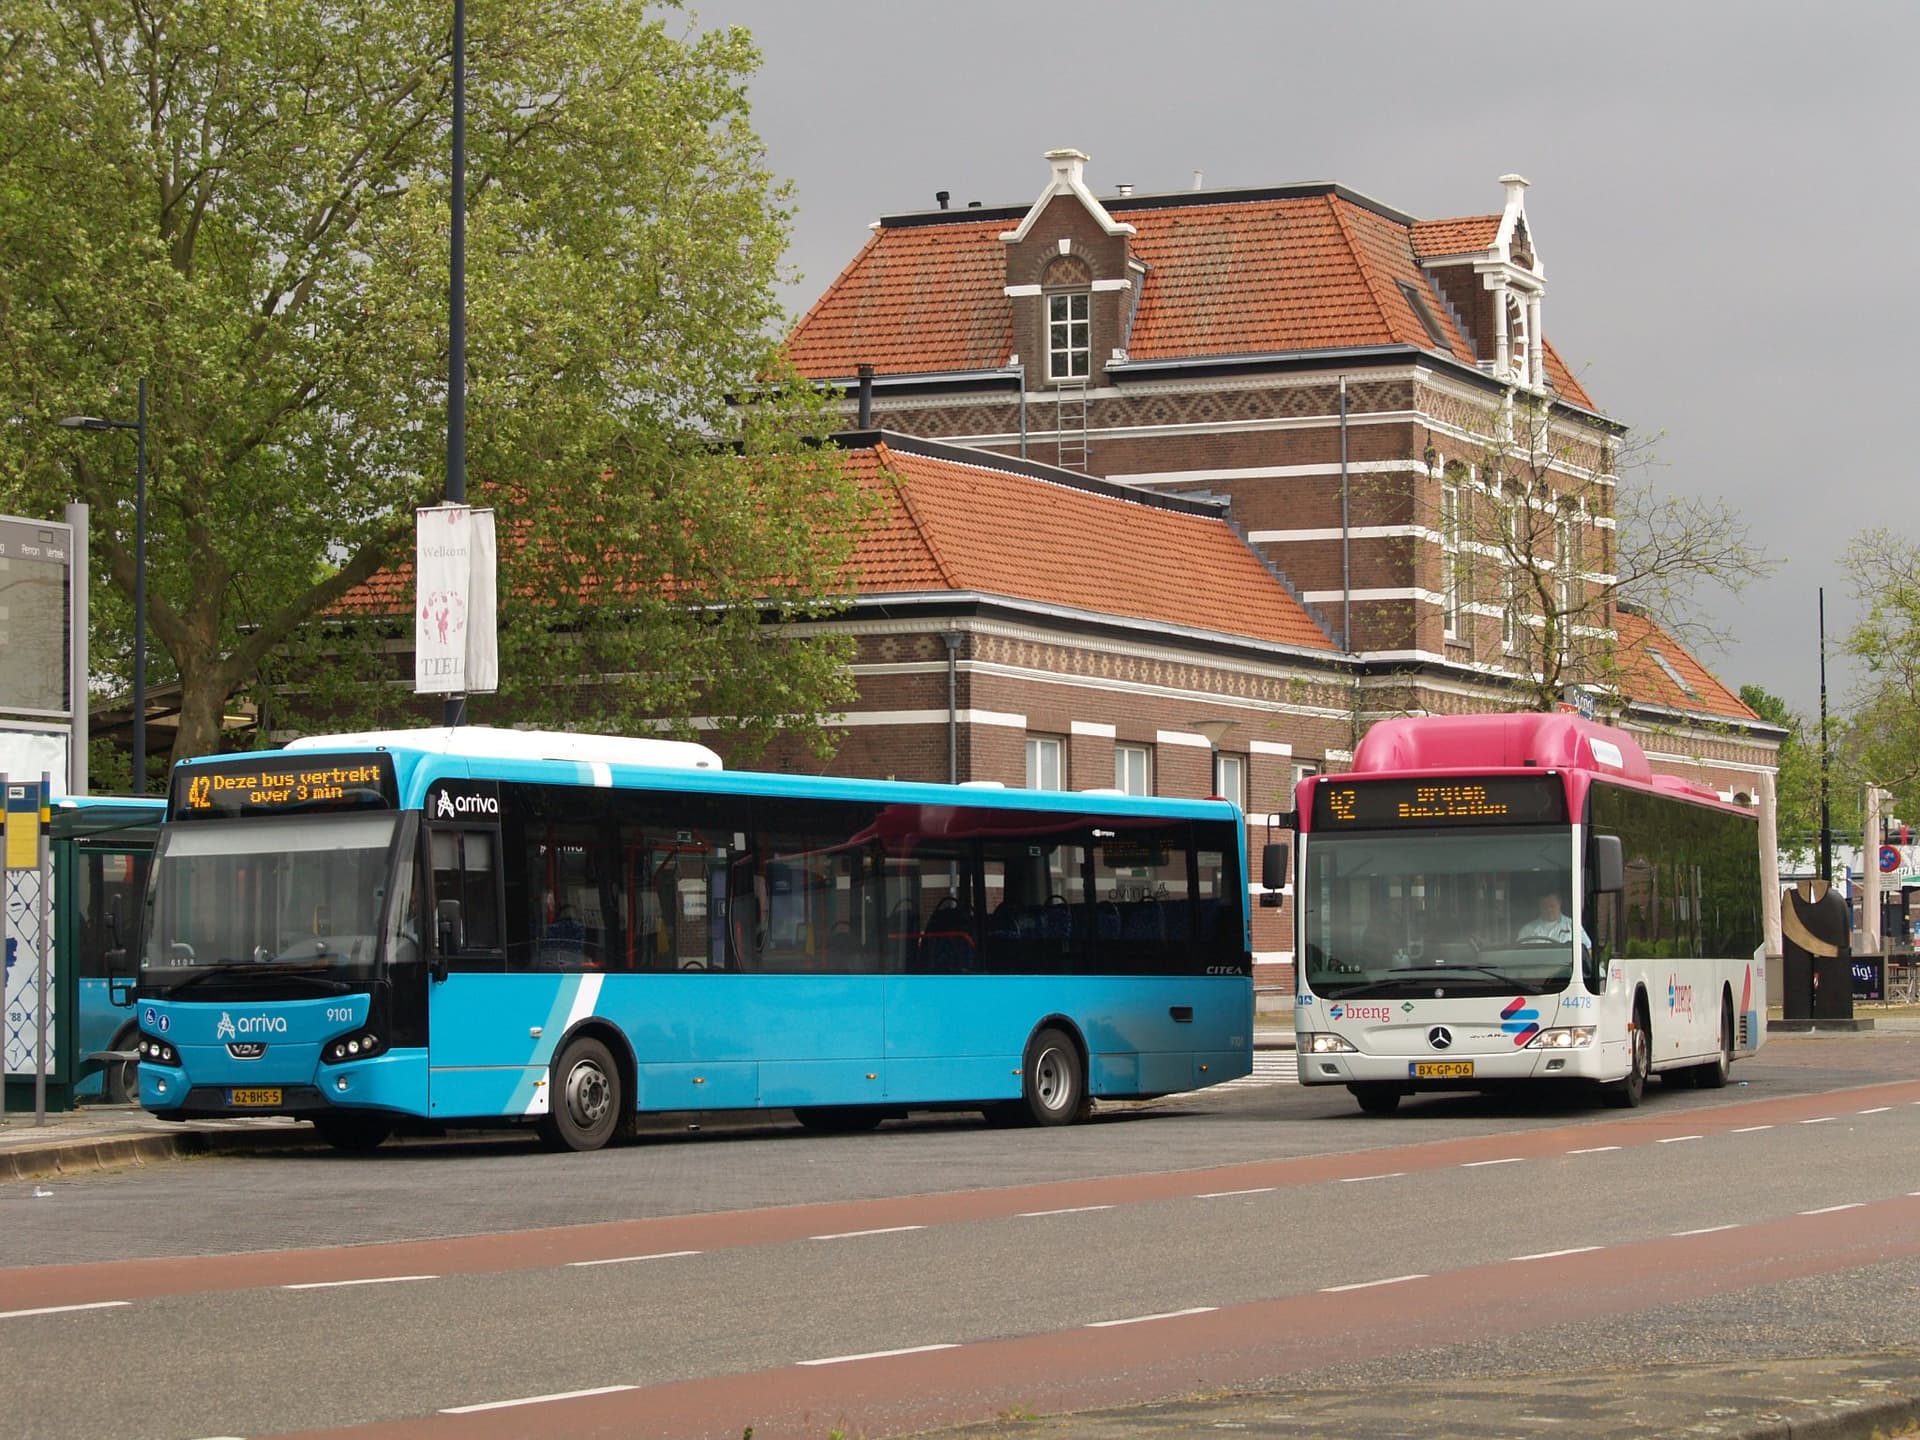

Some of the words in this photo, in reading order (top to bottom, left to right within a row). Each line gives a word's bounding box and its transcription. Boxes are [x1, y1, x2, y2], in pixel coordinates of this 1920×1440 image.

[422, 546, 466, 558] Welkom
[420, 657, 463, 676] TIEL
[213, 775, 257, 791] Deze
[261, 772, 296, 788] bus
[300, 766, 381, 786] vertrekt
[188, 776, 212, 809] 42
[250, 788, 291, 803] over
[296, 785, 308, 801] 3
[313, 784, 343, 800] min
[455, 793, 499, 813] arriva
[1205, 966, 1243, 975] CITEA
[1561, 996, 1592, 1009] 4478
[326, 1008, 353, 1022] 9101
[1345, 1003, 1391, 1023] breng
[237, 1013, 288, 1033] arriva
[231, 1044, 261, 1055] VDL
[1418, 1064, 1470, 1075] BX-GP-06
[234, 1091, 280, 1103] 62-BHS-5
